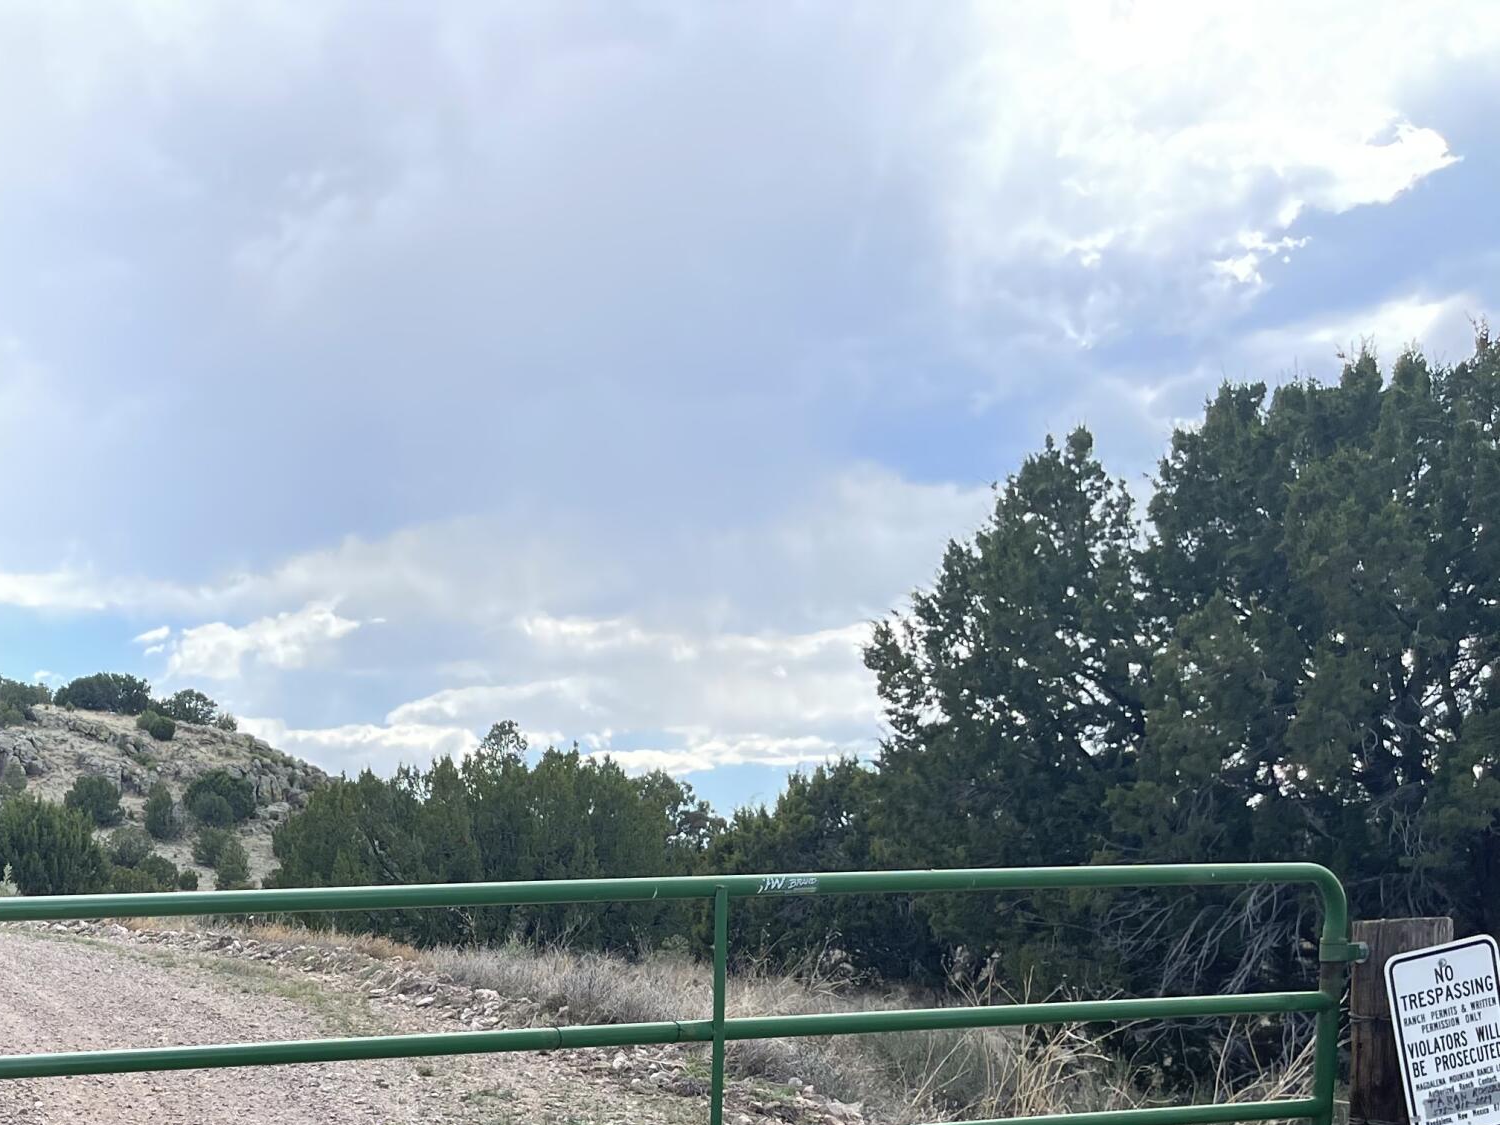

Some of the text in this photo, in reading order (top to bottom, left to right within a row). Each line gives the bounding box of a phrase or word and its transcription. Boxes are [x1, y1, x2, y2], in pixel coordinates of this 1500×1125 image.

[1434, 965, 1454, 984] NO
[1400, 975, 1493, 1012] TRESPASSING
[1403, 996, 1497, 1027] RANCH PERMITS & WRITTEN
[1421, 1011, 1482, 1034] PERMISSION ONLY
[1407, 1022, 1500, 1059] VIOLATORS WILL
[1412, 1060, 1428, 1078] BE
[1416, 1078, 1446, 1091] MAGDALENA
[1449, 1070, 1475, 1083] MOUNTAIN
[1477, 1065, 1494, 1076] RANCH
